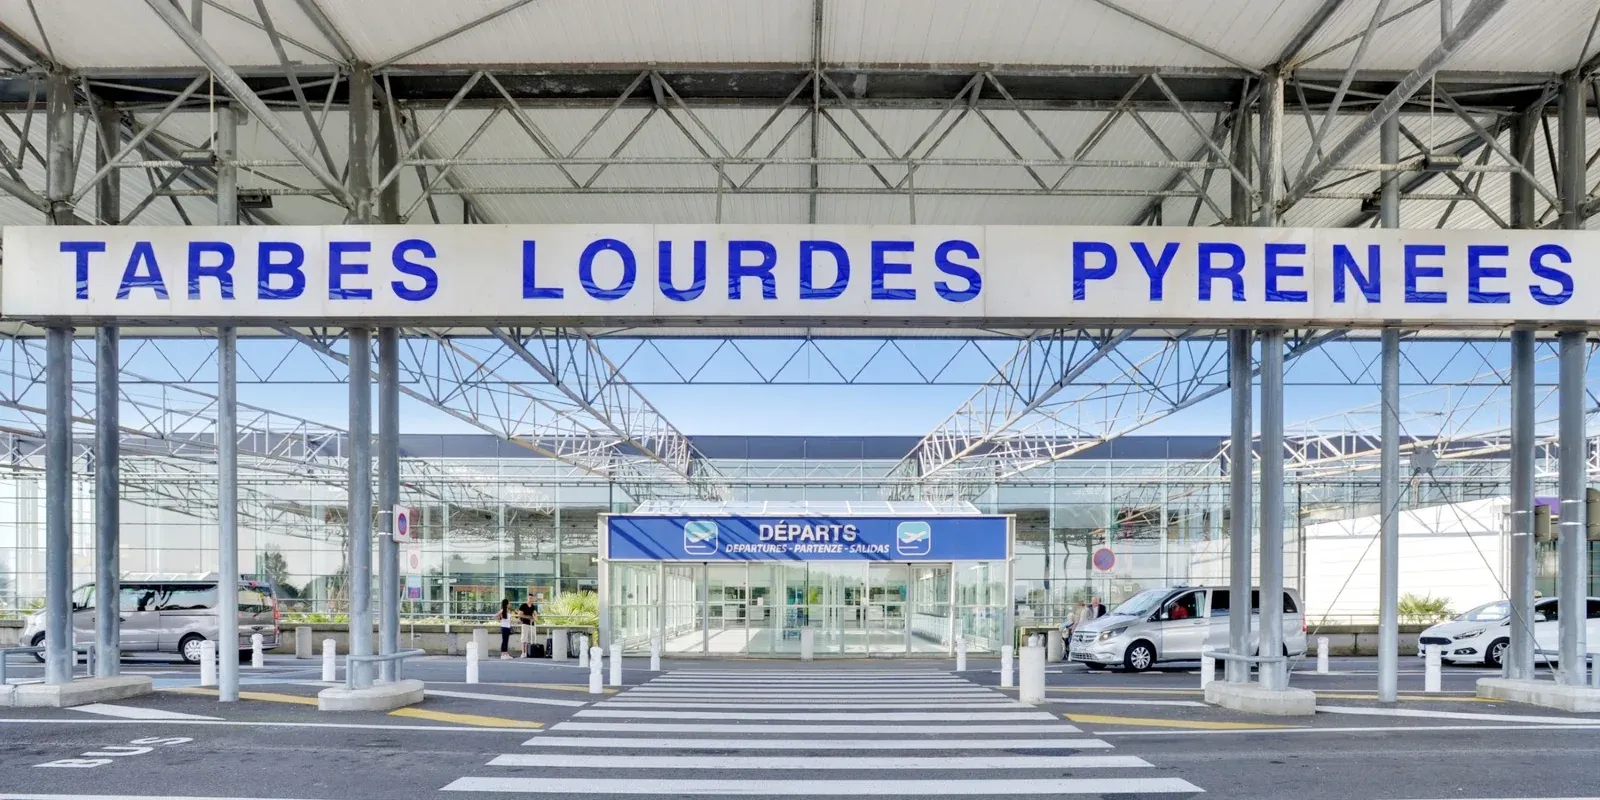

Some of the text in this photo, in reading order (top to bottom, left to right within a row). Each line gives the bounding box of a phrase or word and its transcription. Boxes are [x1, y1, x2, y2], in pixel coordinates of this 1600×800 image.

[60, 238, 1575, 306] TARBES LOURDES PYRENEES
[759, 519, 857, 542] DÉPARTS
[725, 543, 787, 553] DEPARTURES
[794, 543, 843, 553] PARTENZE
[849, 543, 890, 554] SALIDAS
[32, 736, 194, 768] BUS
